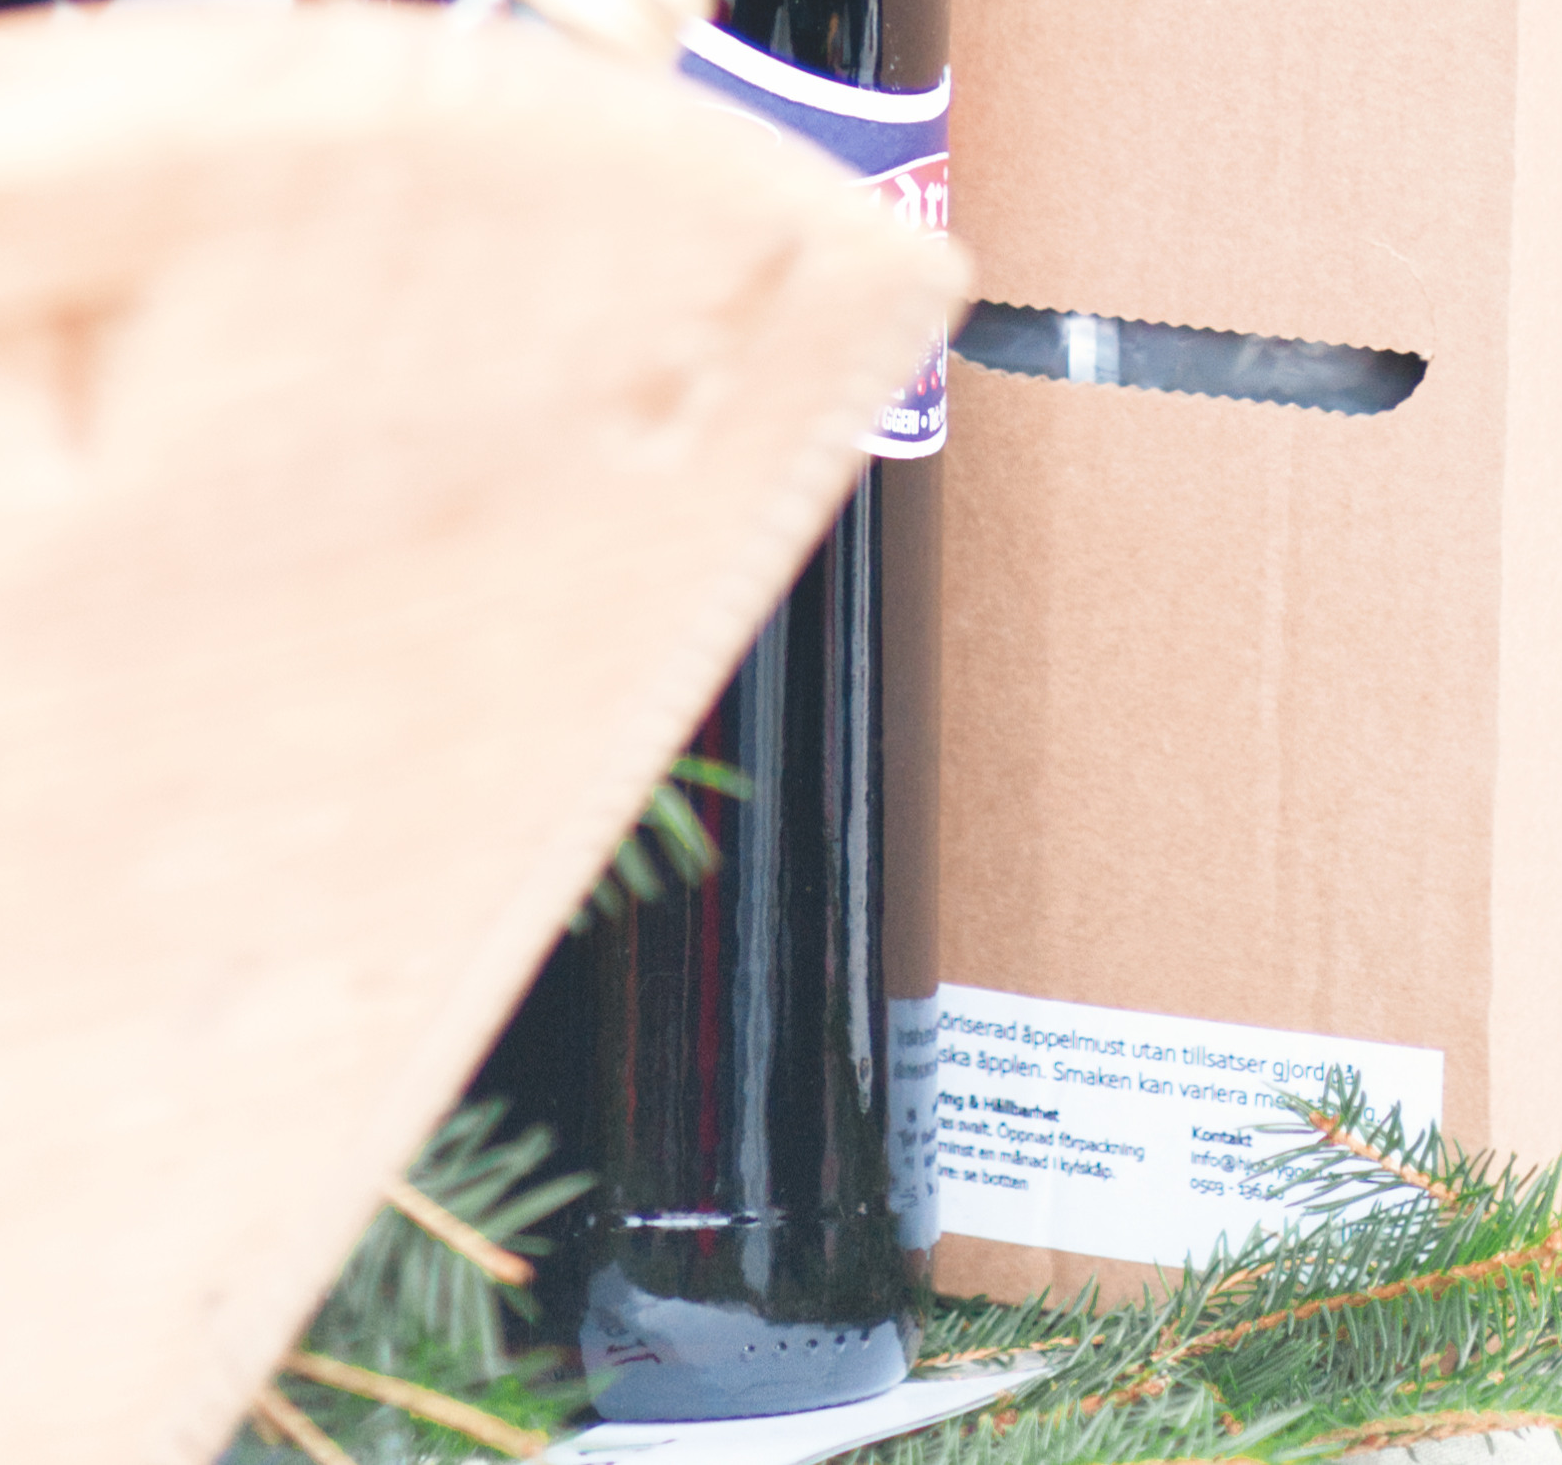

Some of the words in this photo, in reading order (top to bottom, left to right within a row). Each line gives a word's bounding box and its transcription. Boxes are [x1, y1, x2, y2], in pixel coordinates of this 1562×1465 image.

[937, 1011, 1017, 1042] öriserad
[1022, 1025, 1126, 1058] äppelmust
[1132, 1041, 1176, 1063] utan
[1182, 1045, 1267, 1075] tillsatser
[1272, 1059, 1325, 1083] gjord
[976, 1050, 1047, 1079] äpplen.
[1052, 1061, 1132, 1091] Smaken
[1139, 1071, 1173, 1096] kan
[1179, 1080, 1248, 1105] variera
[984, 1096, 1060, 1123] Hållbarhet
[997, 1121, 1054, 1147] Öppnad
[1058, 1130, 1146, 1163] förpackning
[1191, 1125, 1253, 1148] Kontakt
[982, 1168, 1029, 1191] botten
[1000, 1149, 1050, 1170] månad
[1060, 1155, 1117, 1183] kylskåp.
